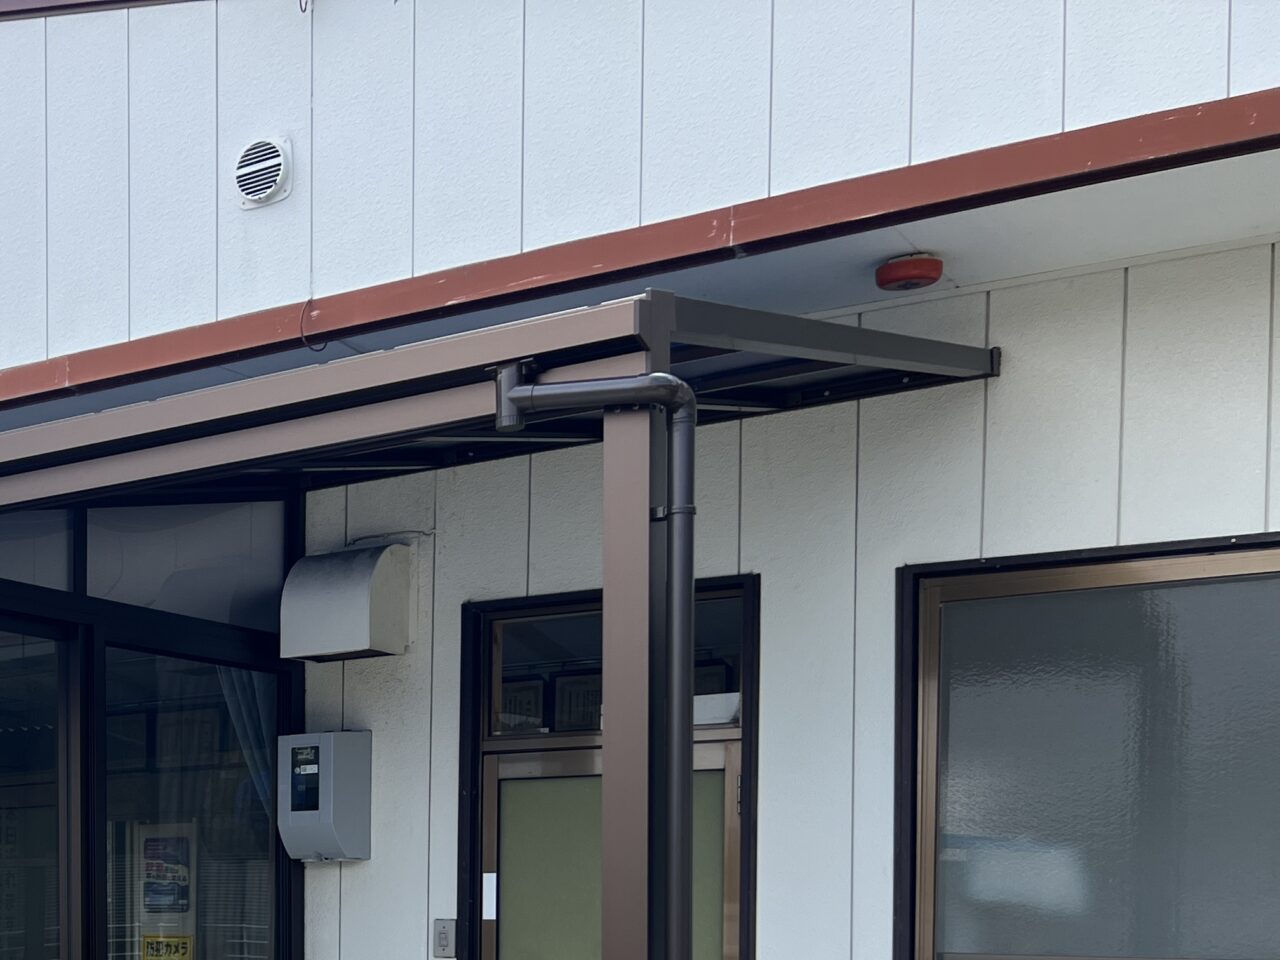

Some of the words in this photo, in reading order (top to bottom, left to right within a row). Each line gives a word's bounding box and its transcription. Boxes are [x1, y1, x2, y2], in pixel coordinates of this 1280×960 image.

[146, 941, 188, 957] 防犯カメラ
